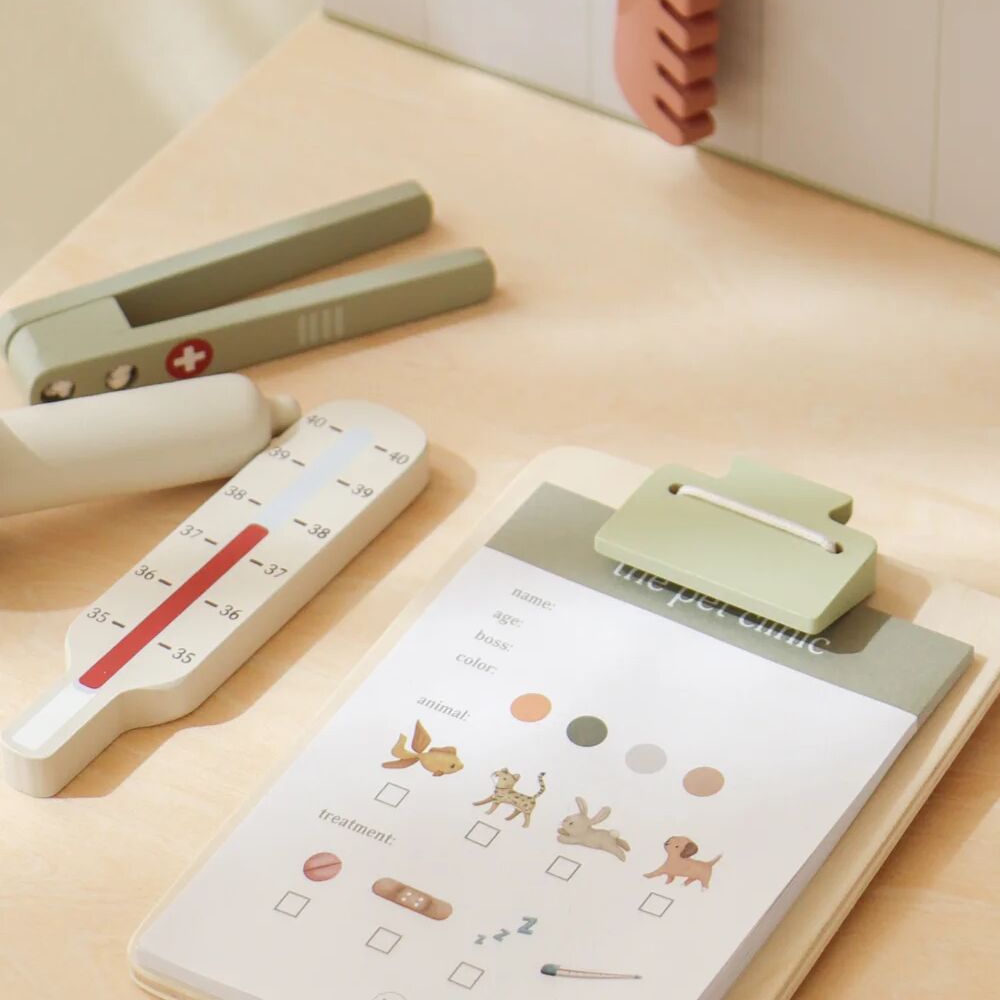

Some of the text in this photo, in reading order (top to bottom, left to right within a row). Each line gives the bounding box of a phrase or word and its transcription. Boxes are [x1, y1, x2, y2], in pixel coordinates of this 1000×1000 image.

[306, 414, 328, 428] 40
[268, 446, 291, 461] 39
[388, 451, 410, 465] 40
[224, 485, 247, 501] 38
[351, 483, 374, 498] 39
[179, 524, 204, 539] 37
[307, 523, 331, 539] 38
[133, 564, 155, 581] 36
[263, 563, 288, 579] 37
[511, 587, 556, 611] name:
[86, 607, 111, 623] 35
[219, 604, 241, 621] 36
[492, 609, 524, 628] age:
[474, 629, 514, 652] boss:
[171, 647, 196, 664] 35
[455, 651, 499, 675] color:
[416, 695, 471, 722] animal:
[318, 808, 396, 846] treatment:
